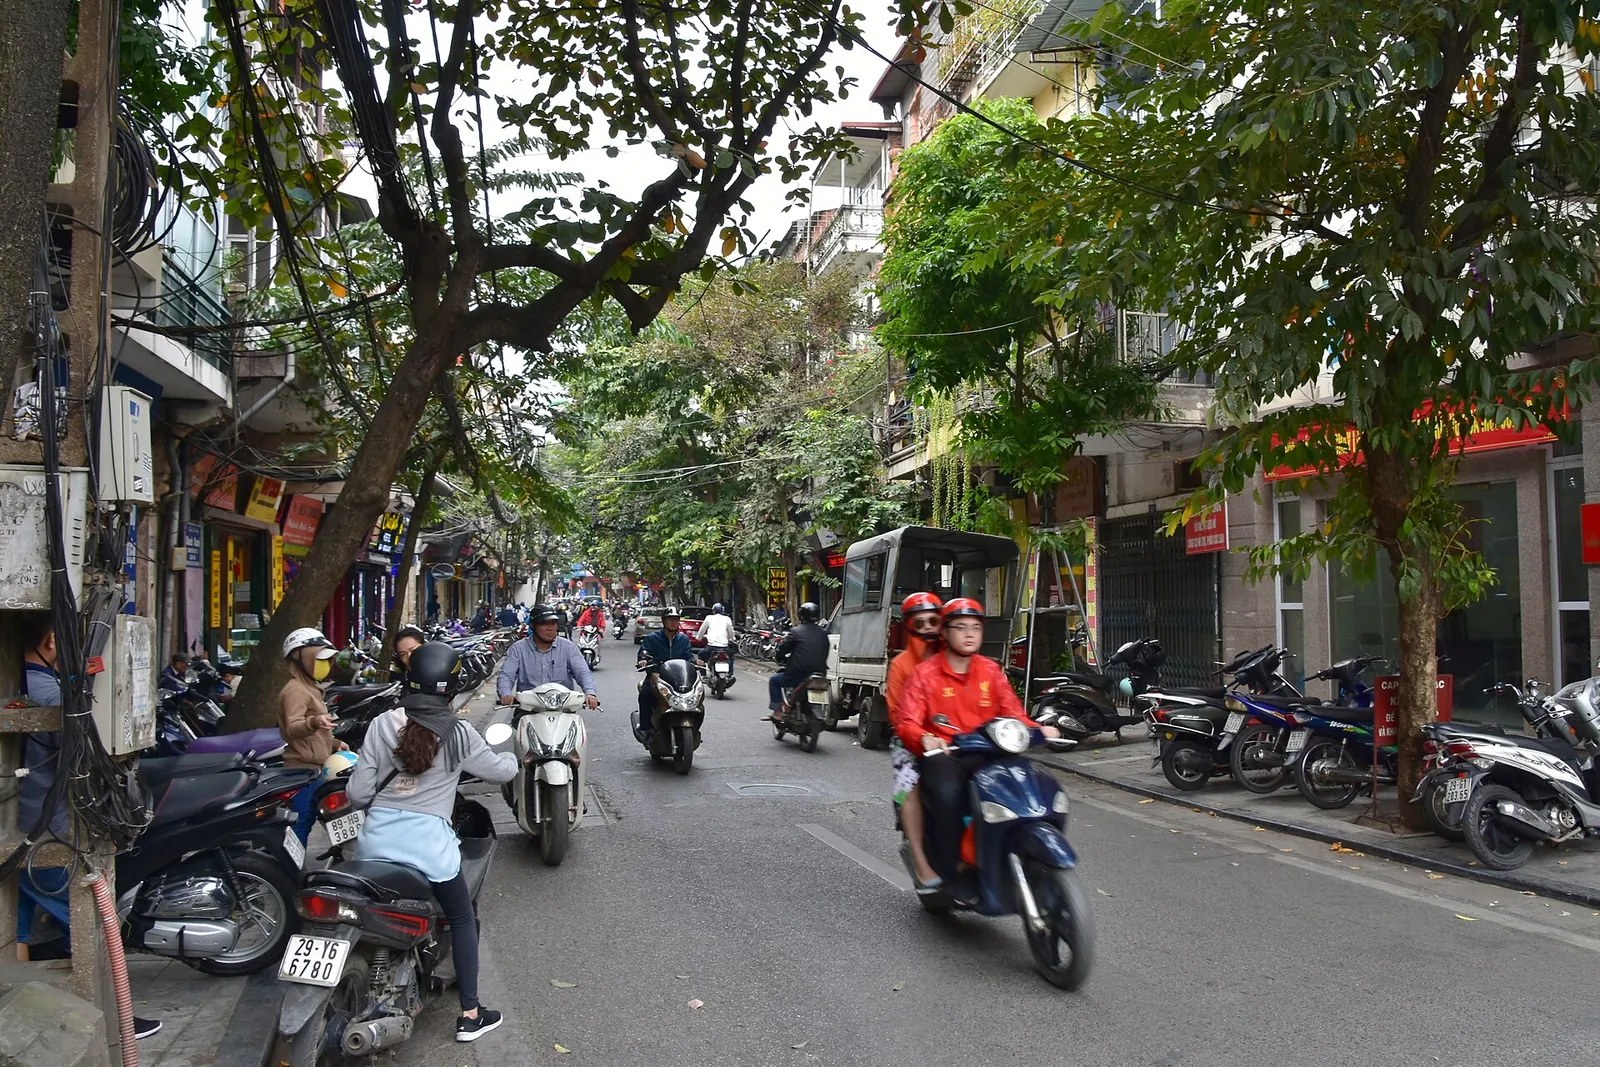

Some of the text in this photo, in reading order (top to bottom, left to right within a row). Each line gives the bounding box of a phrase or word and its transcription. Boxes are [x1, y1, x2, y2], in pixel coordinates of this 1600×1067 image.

[331, 812, 360, 832] 89-H9
[294, 938, 340, 960] 29-Y6
[288, 958, 333, 980] 6780
